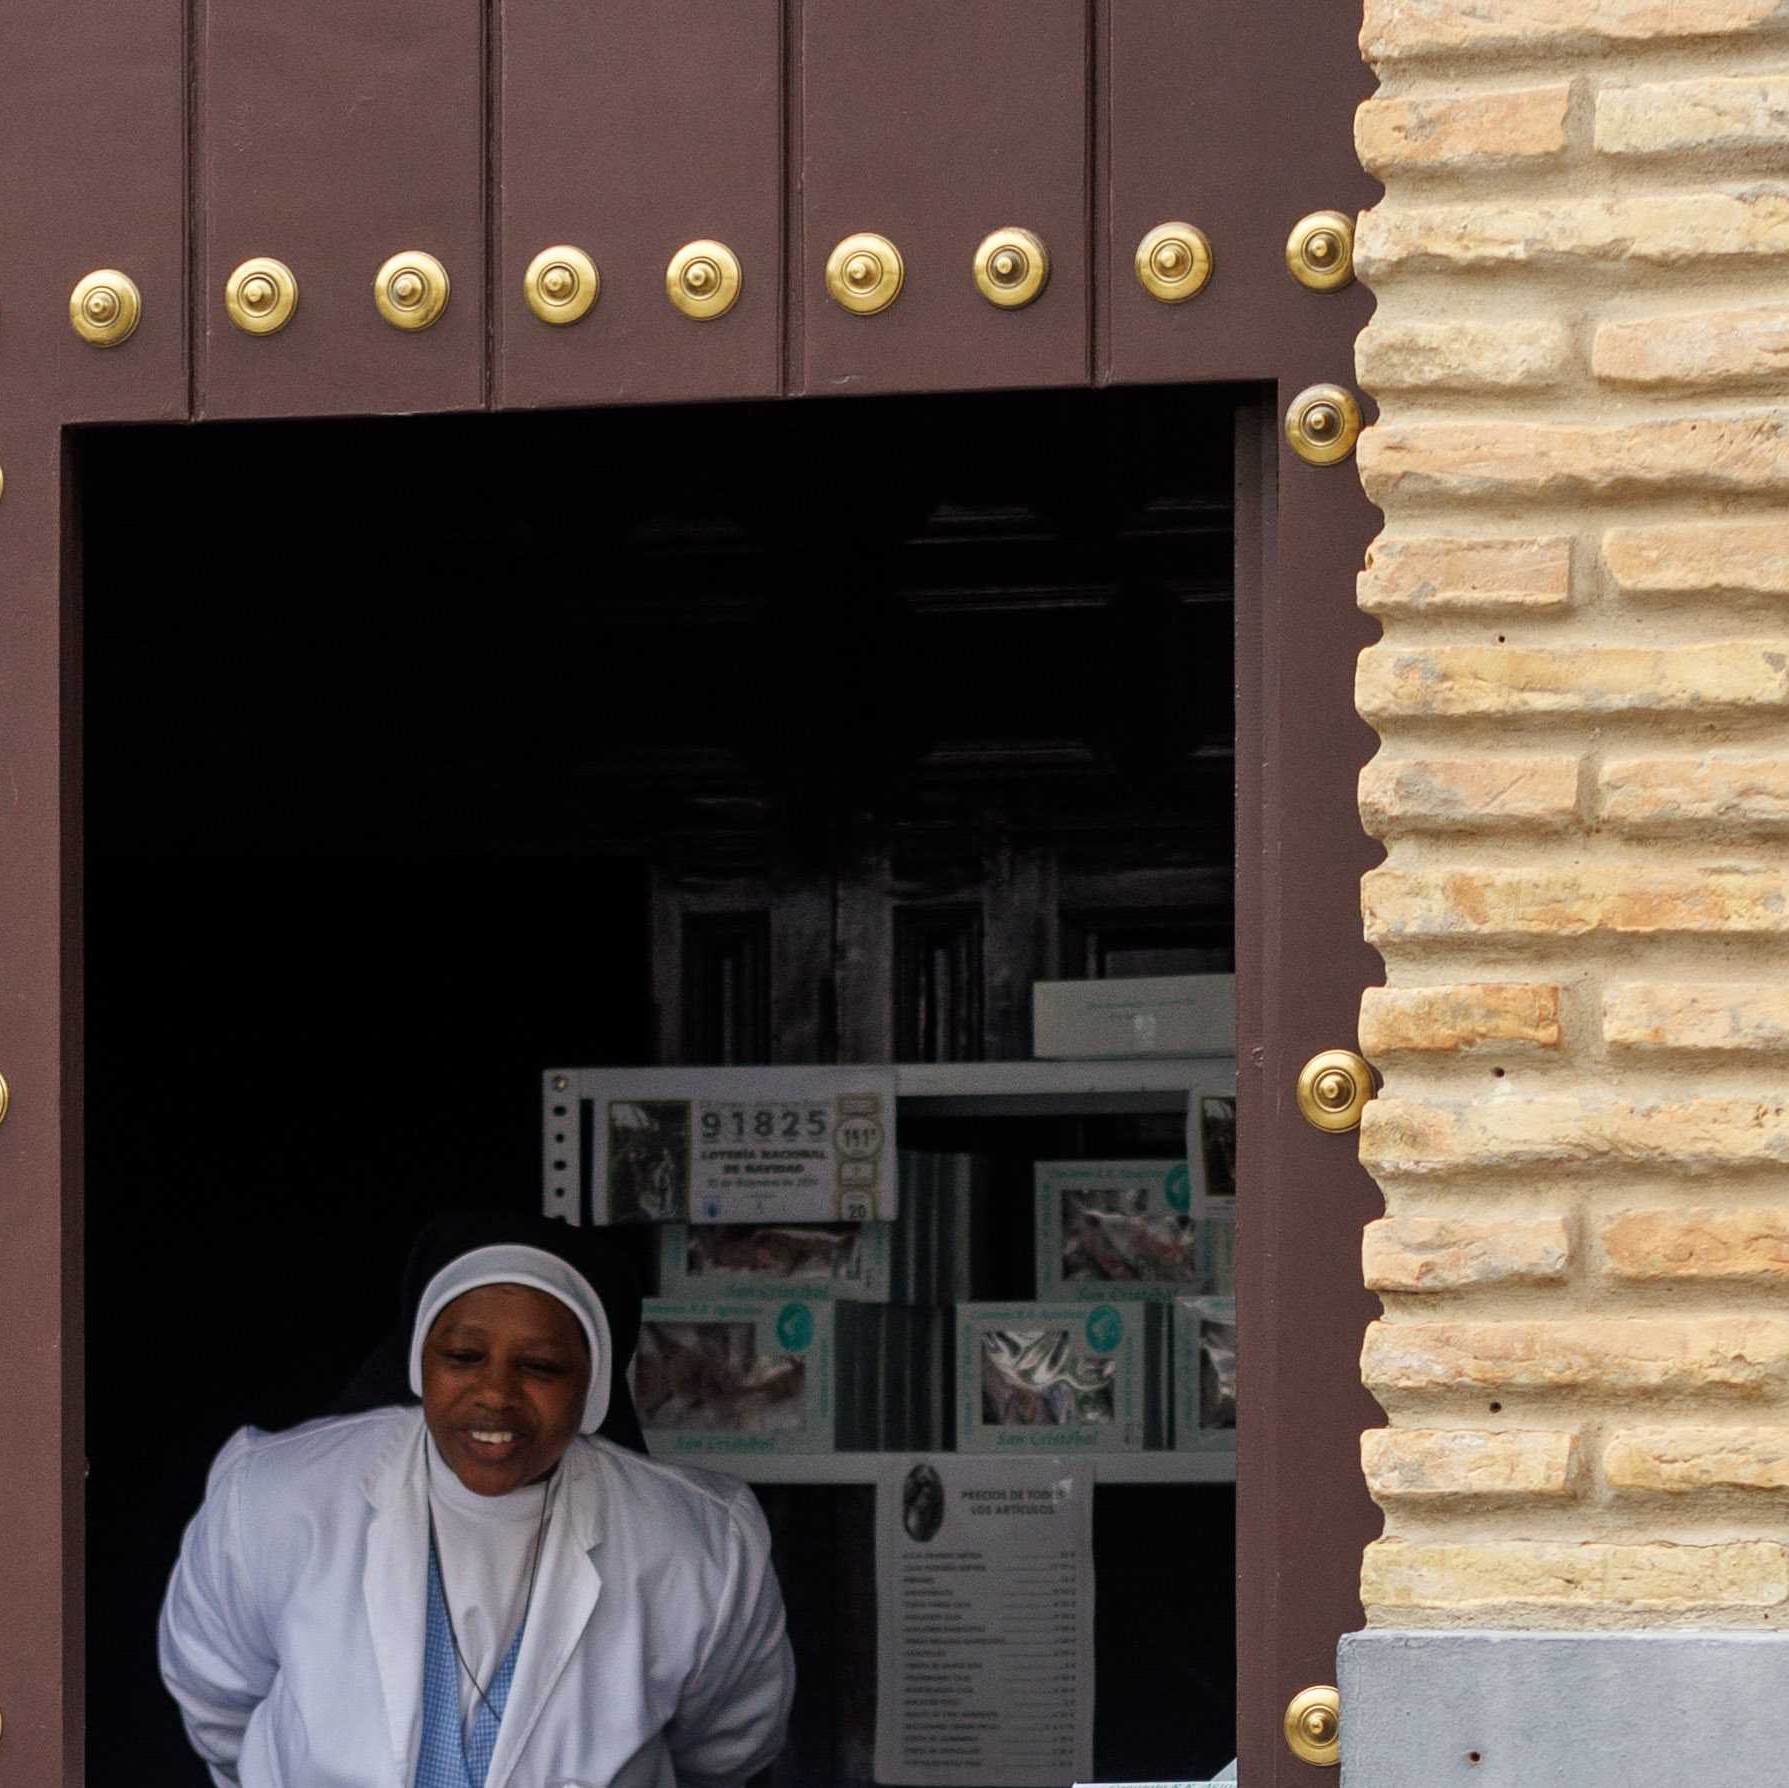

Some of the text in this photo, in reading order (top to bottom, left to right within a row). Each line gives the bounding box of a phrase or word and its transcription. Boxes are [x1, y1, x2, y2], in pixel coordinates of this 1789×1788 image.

[701, 1110, 826, 1138] 91825
[701, 1148, 826, 1160] LOTERÍA NACIONAL
[745, 1164, 805, 1174] NAVIDAD
[997, 1431, 1025, 1445] San
[962, 1489, 1007, 1501] PRECIOS
[1010, 1489, 1024, 1501] DE
[972, 1503, 1055, 1516] LOS ARTÍCULOS
